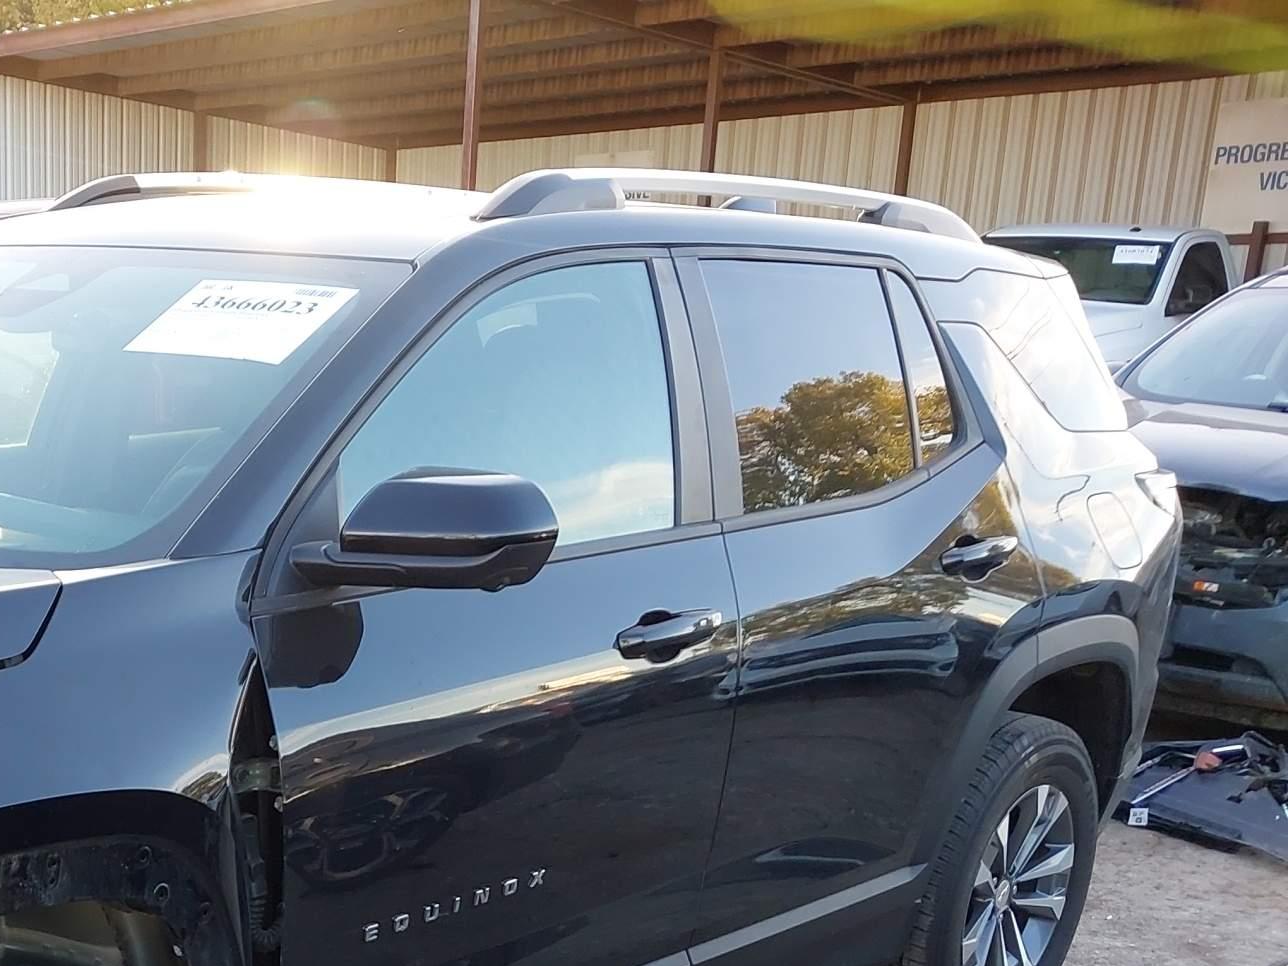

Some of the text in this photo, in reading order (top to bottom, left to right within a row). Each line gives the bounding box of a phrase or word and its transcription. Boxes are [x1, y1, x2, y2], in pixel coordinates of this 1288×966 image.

[1214, 142, 1288, 166] PROGRE
[1259, 170, 1288, 191] VIC
[192, 295, 318, 315] 43666023
[363, 868, 546, 942] EQUINOX
